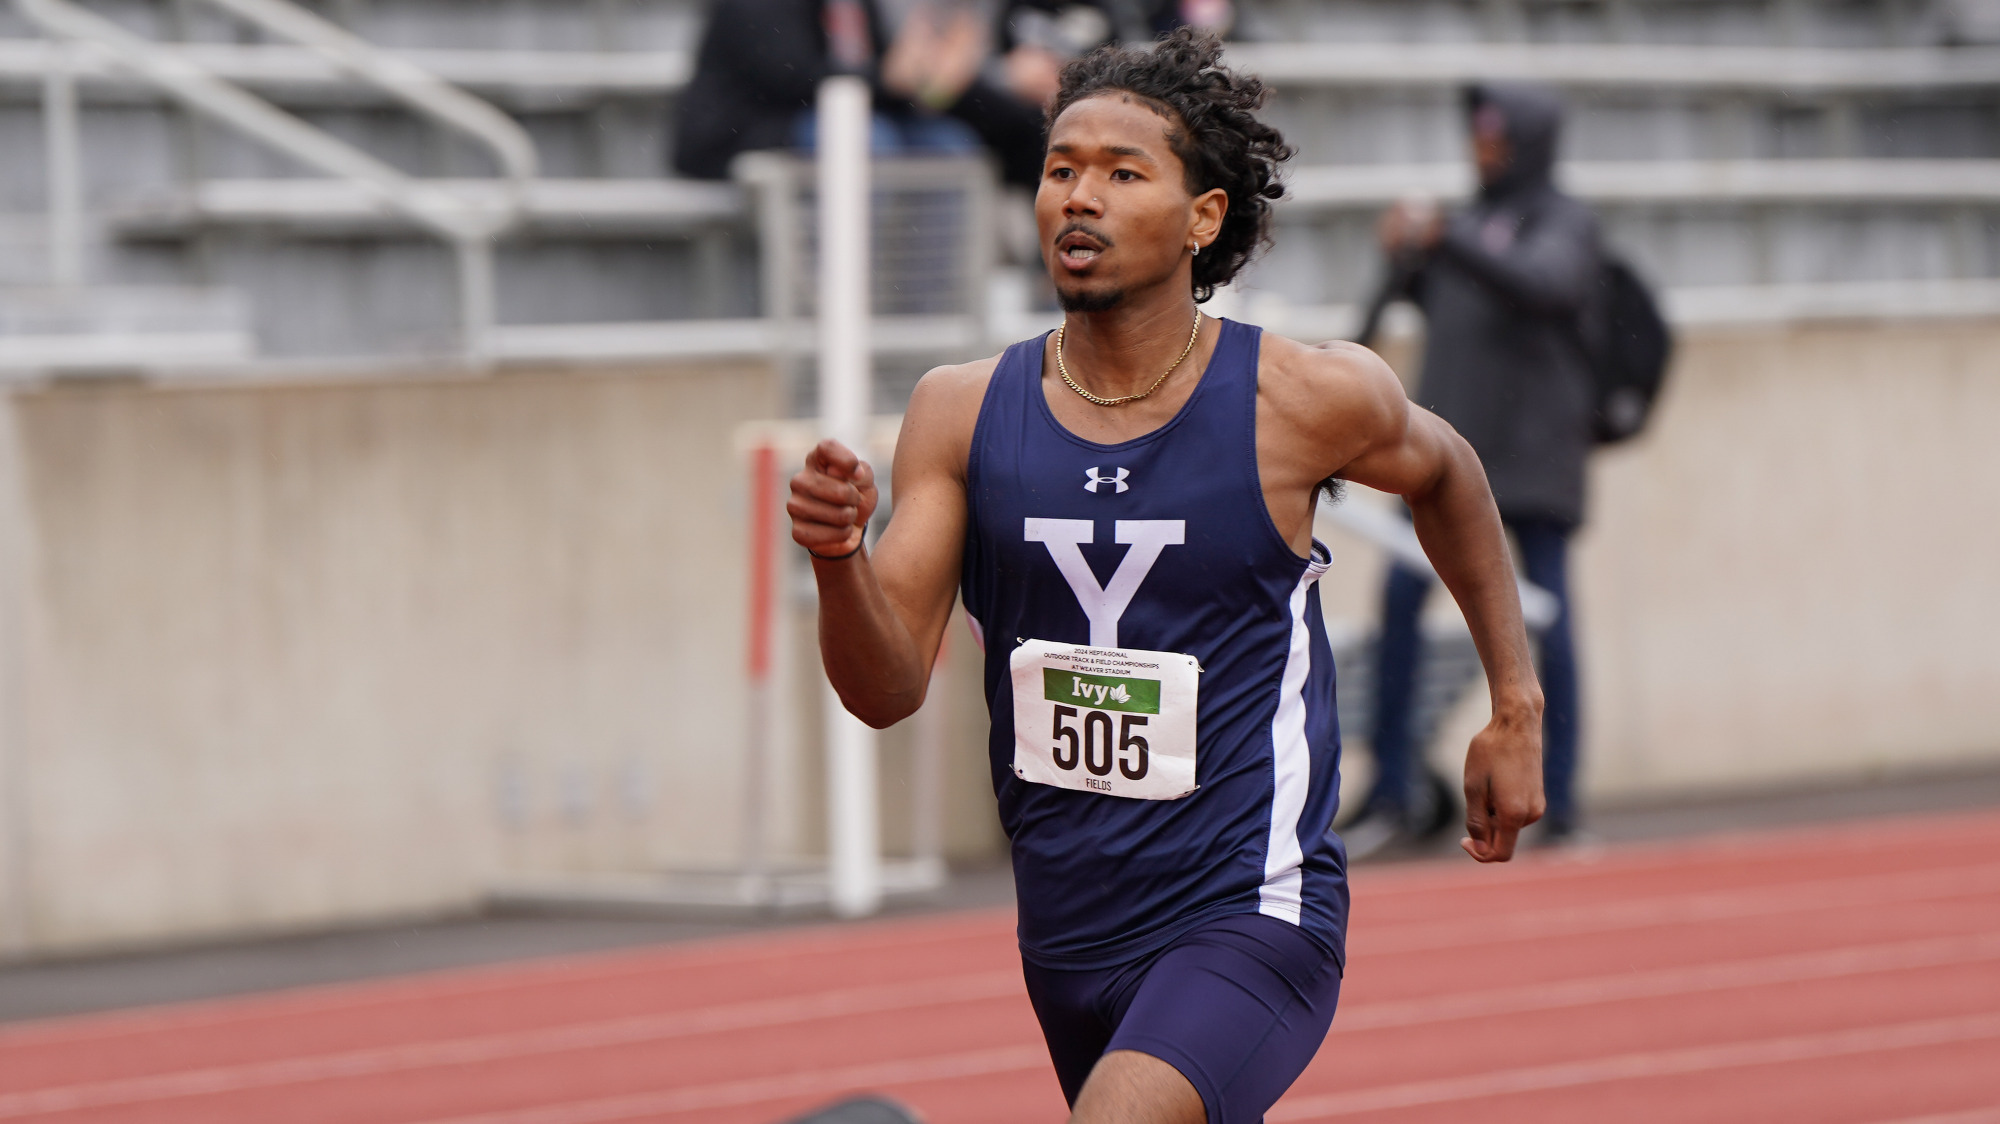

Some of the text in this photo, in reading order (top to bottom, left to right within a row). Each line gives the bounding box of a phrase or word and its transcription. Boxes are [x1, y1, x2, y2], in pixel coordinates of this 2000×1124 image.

[1024, 517, 1186, 648] Y
[1044, 652, 1070, 661] OUTDOOR
[1071, 656, 1090, 664] TRACK
[1112, 660, 1160, 669] CHAMPIONSHIPS
[1089, 650, 1128, 658] HEPTAGONAL
[1080, 665, 1104, 673] WEAVER
[1071, 676, 1110, 705] Ivy
[1052, 704, 1149, 780] 505
[1086, 778, 1112, 791] FIELDS
